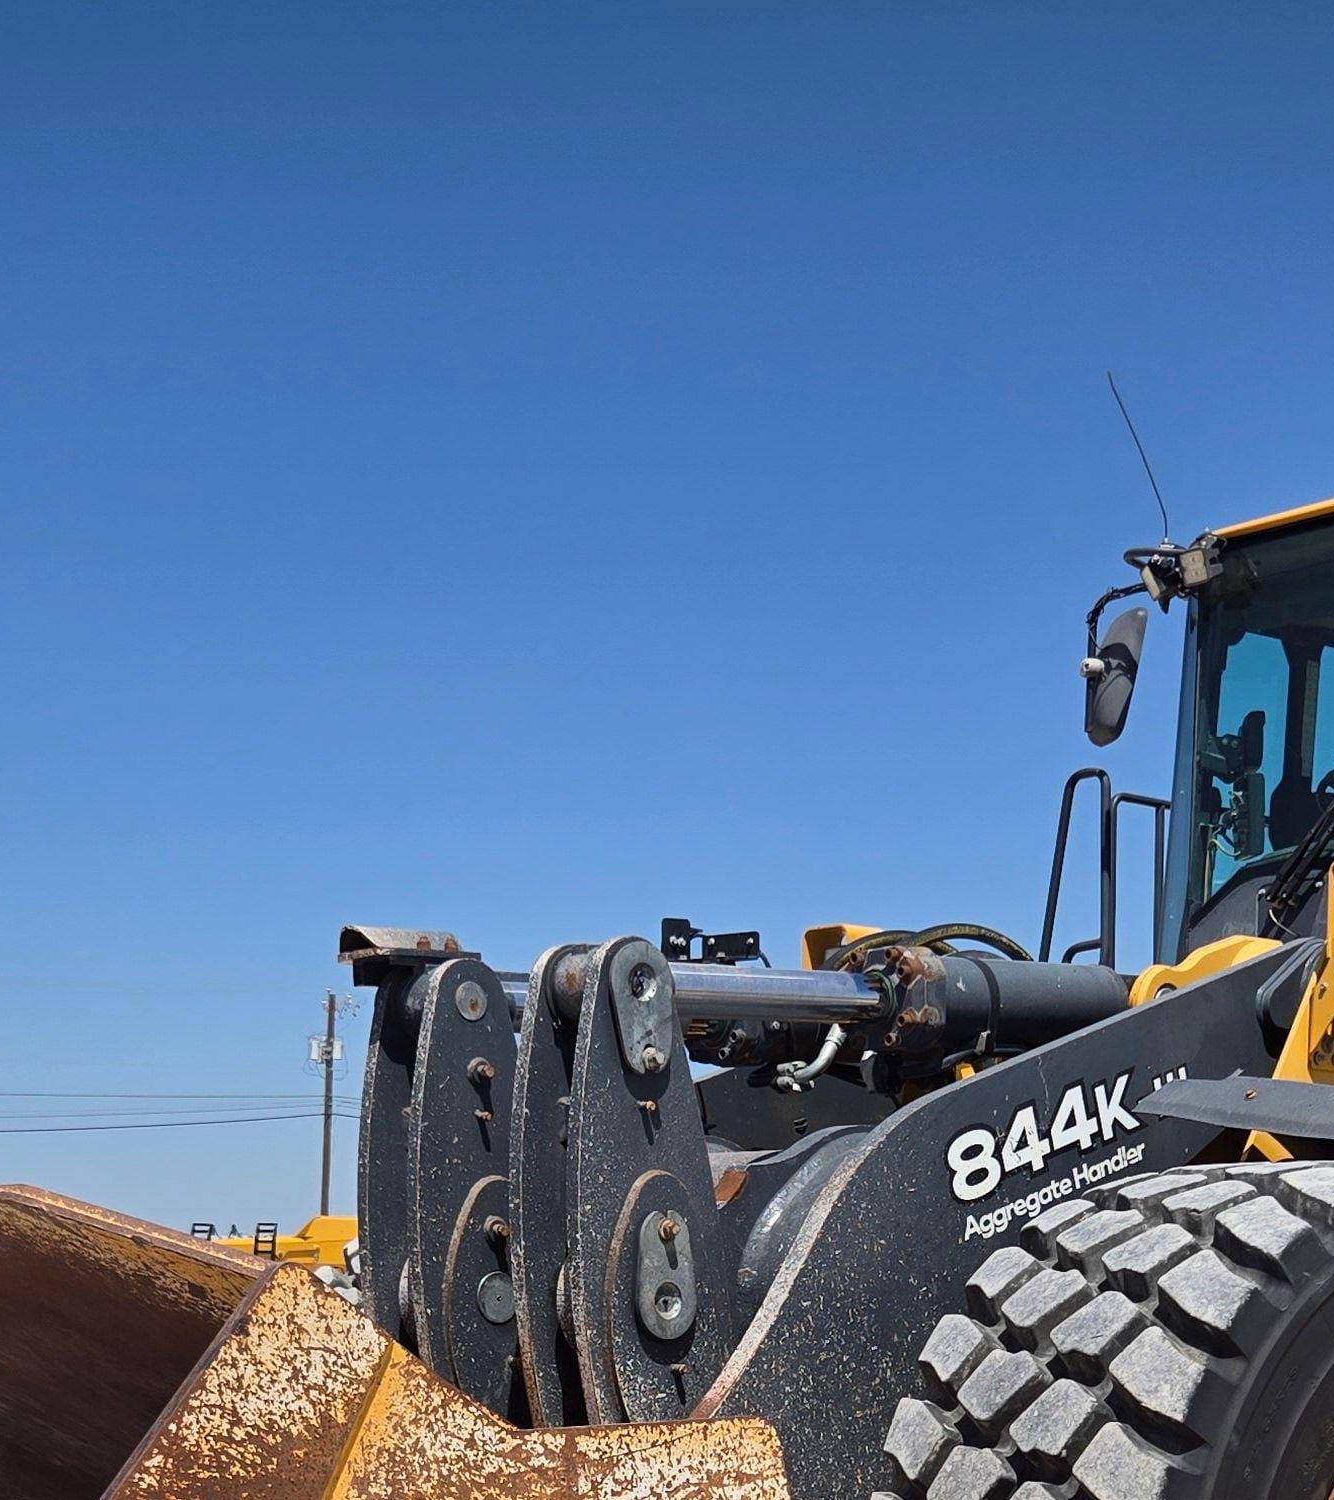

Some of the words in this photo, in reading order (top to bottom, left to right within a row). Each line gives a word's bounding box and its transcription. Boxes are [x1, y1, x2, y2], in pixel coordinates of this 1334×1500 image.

[948, 1073, 1140, 1201] 844K
[963, 1176, 1074, 1241] Aggregate
[1072, 1142, 1145, 1190] Handler
